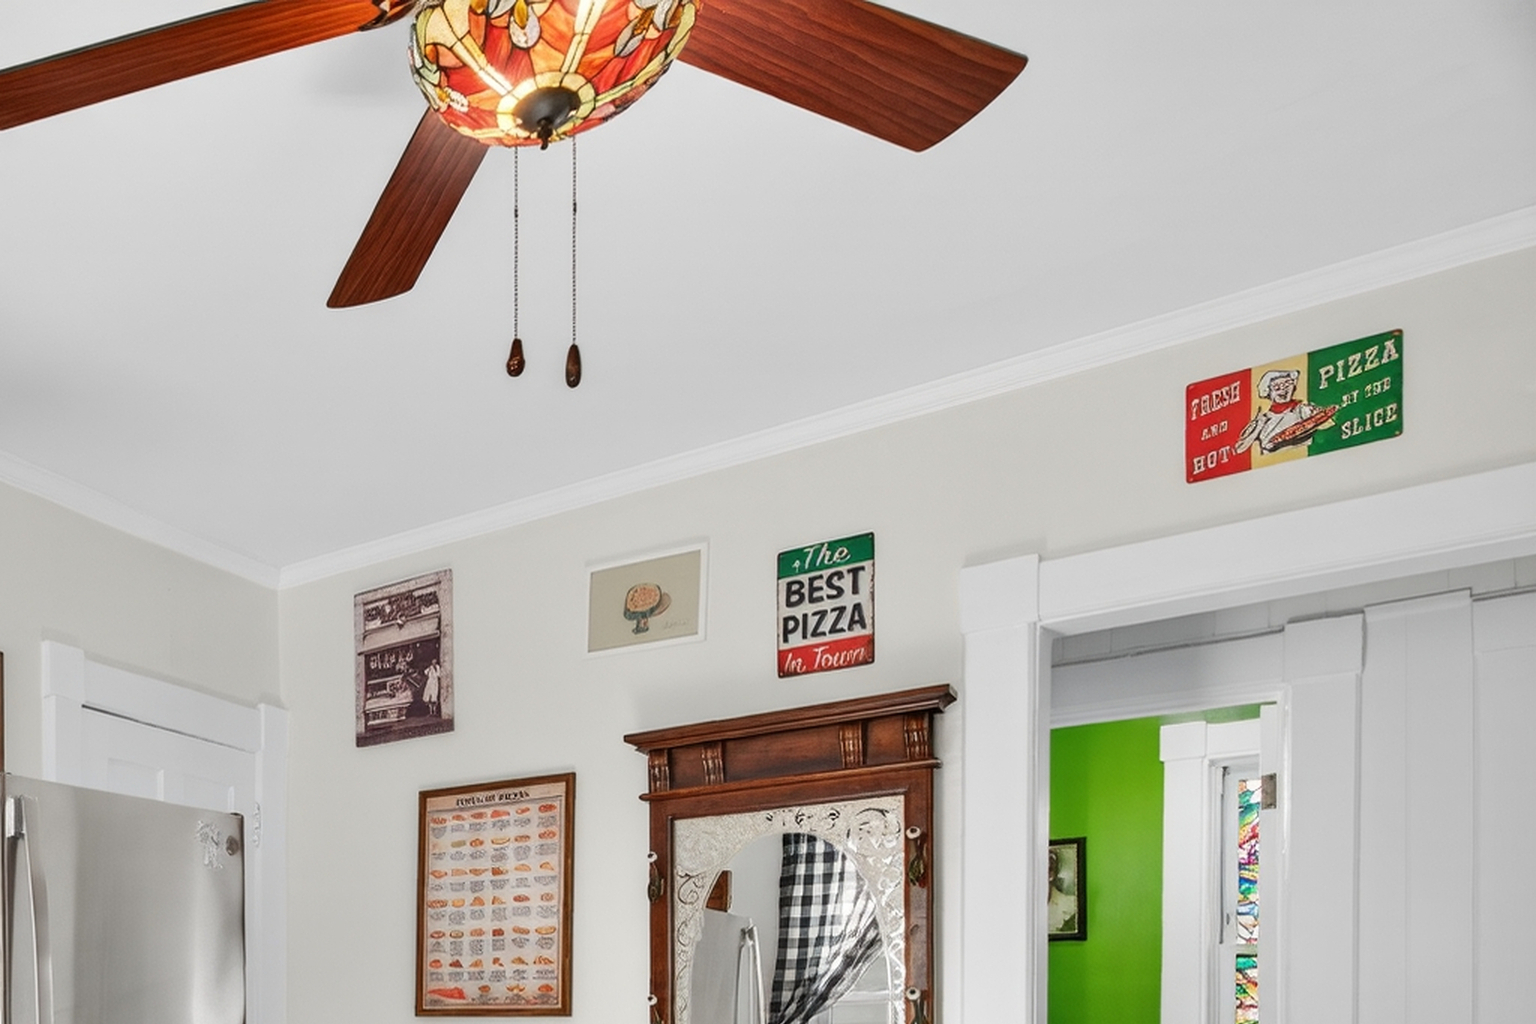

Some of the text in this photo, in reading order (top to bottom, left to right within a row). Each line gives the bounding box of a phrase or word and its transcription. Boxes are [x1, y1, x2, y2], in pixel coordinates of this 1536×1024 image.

[1319, 338, 1399, 390] PIZZA
[1191, 381, 1240, 421] FRESH
[1341, 377, 1391, 408] BY THE
[1201, 420, 1228, 441] AND
[1341, 403, 1398, 440] SLICE
[1193, 446, 1230, 475] HOT
[803, 542, 851, 570] The
[785, 566, 866, 608] BEST
[782, 602, 867, 644] PIZZA
[784, 646, 870, 674] In Town
